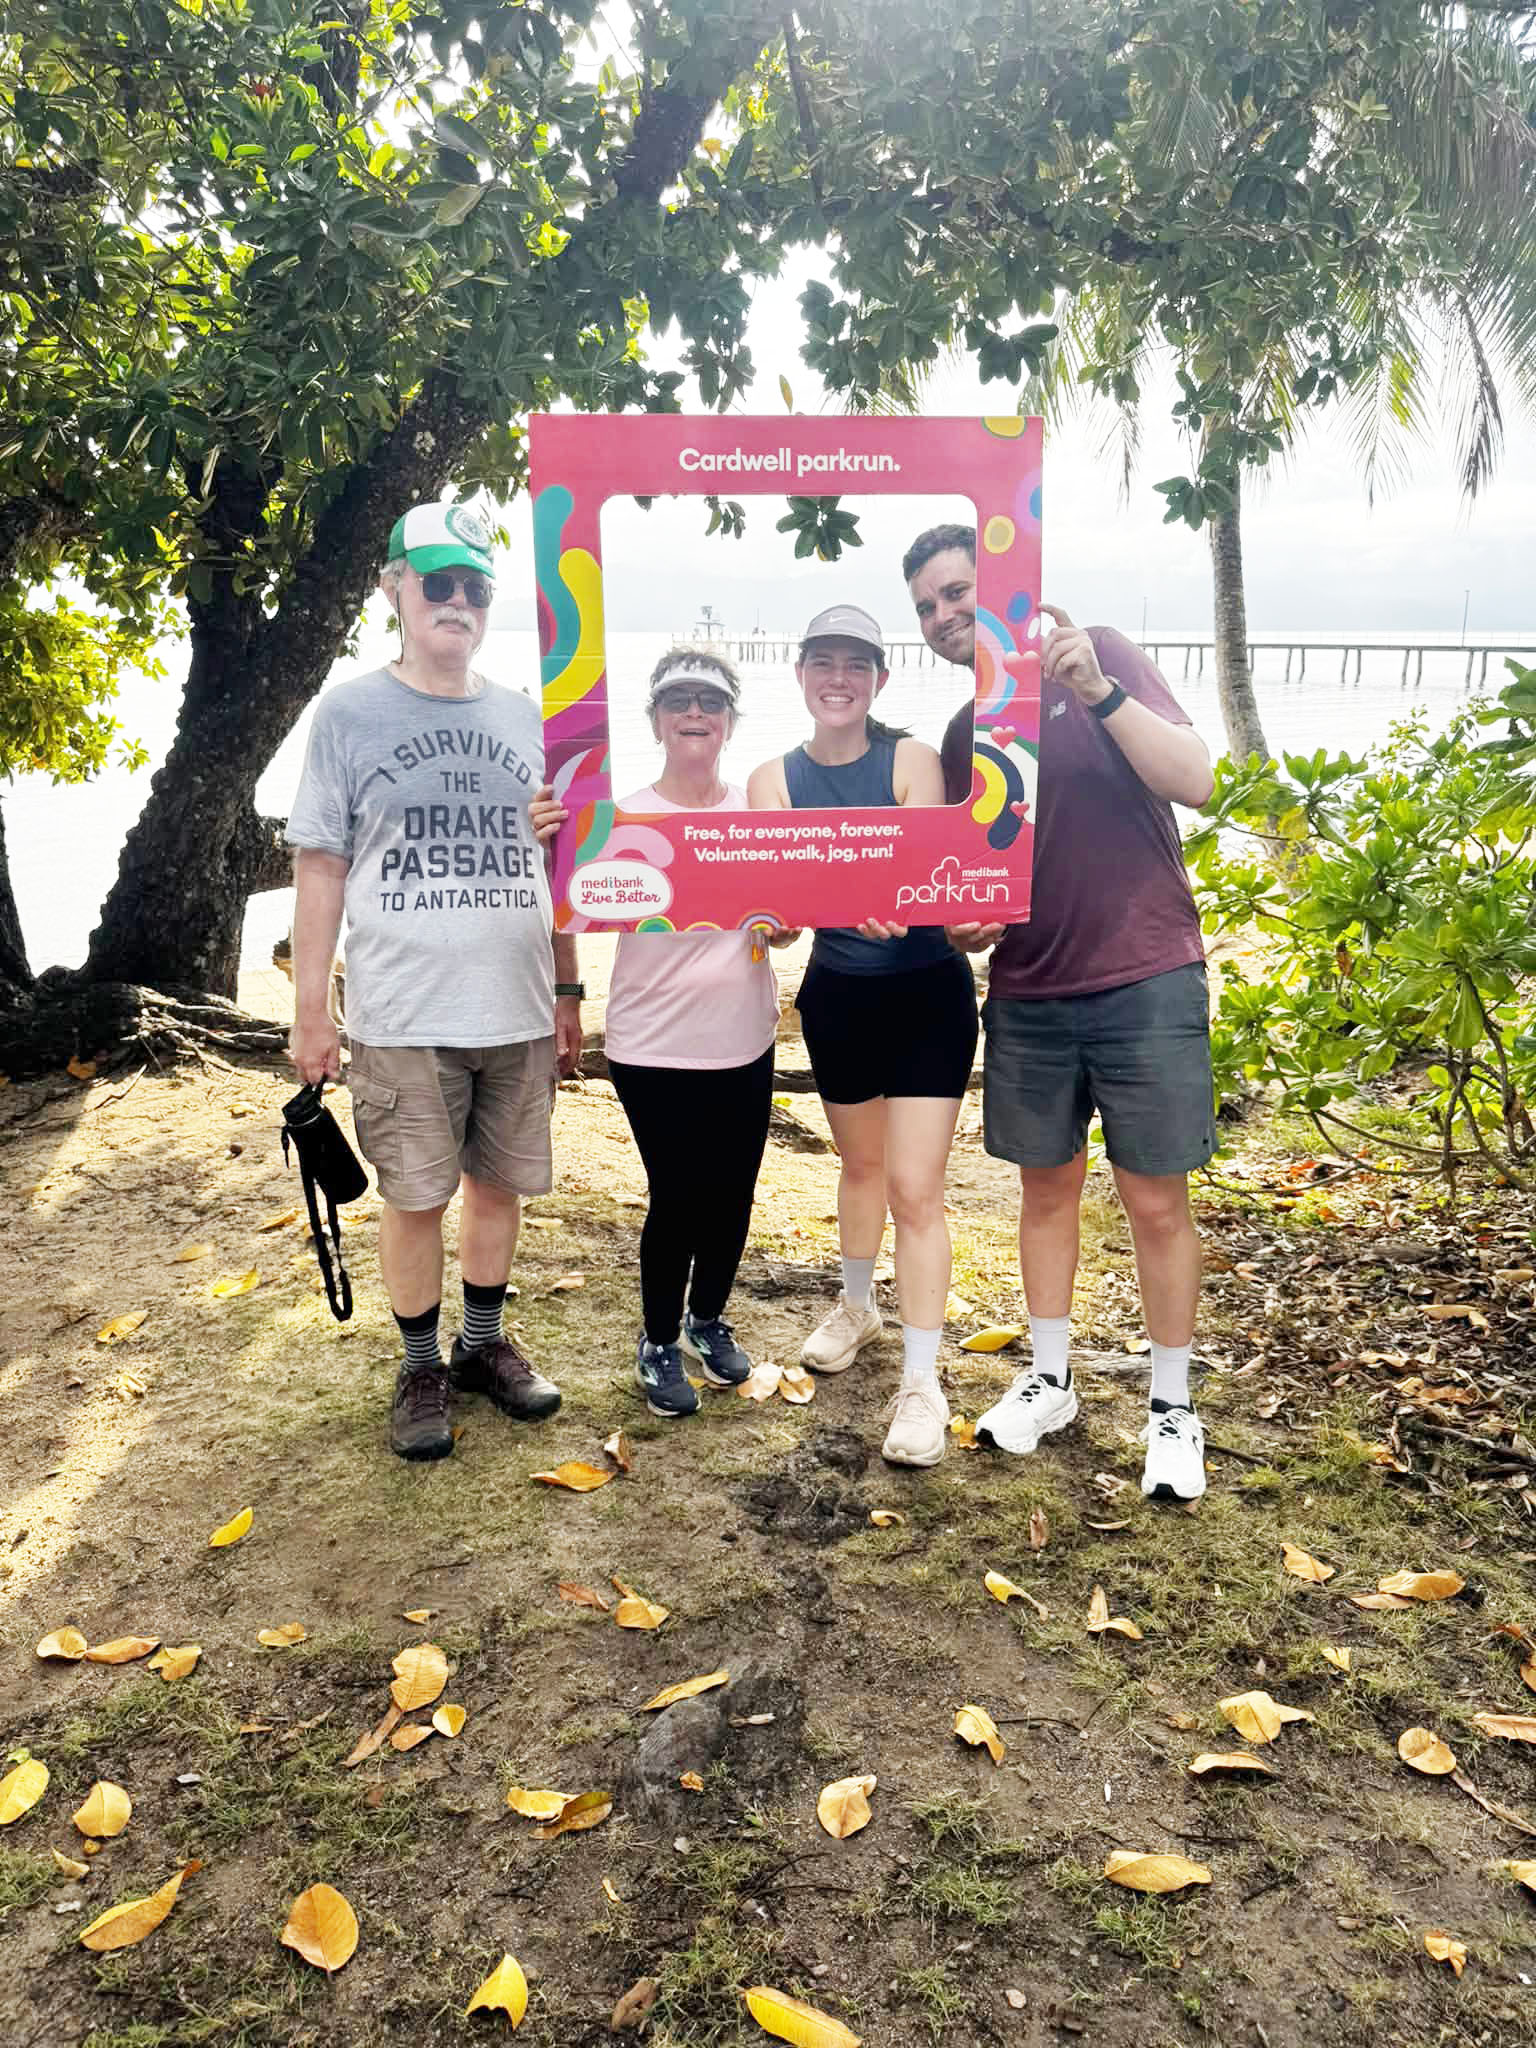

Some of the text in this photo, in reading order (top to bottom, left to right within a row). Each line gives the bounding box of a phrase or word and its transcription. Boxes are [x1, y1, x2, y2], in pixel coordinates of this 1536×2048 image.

[679, 448, 901, 477] Cardwell parkrun.
[376, 729, 532, 785] I SURVIVED
[440, 771, 480, 793] THE
[404, 804, 518, 840] DRAKE
[684, 822, 904, 842] Free, for everyone, forever.
[381, 843, 535, 881] PASSAGE
[694, 843, 894, 863] Volunteer, walk, jog, run!
[581, 876, 645, 889] medibank
[962, 866, 1008, 877] medibank
[380, 888, 538, 912] TO ANTARCTICA
[581, 889, 661, 904] Live Better
[896, 871, 1009, 910] parkrun
